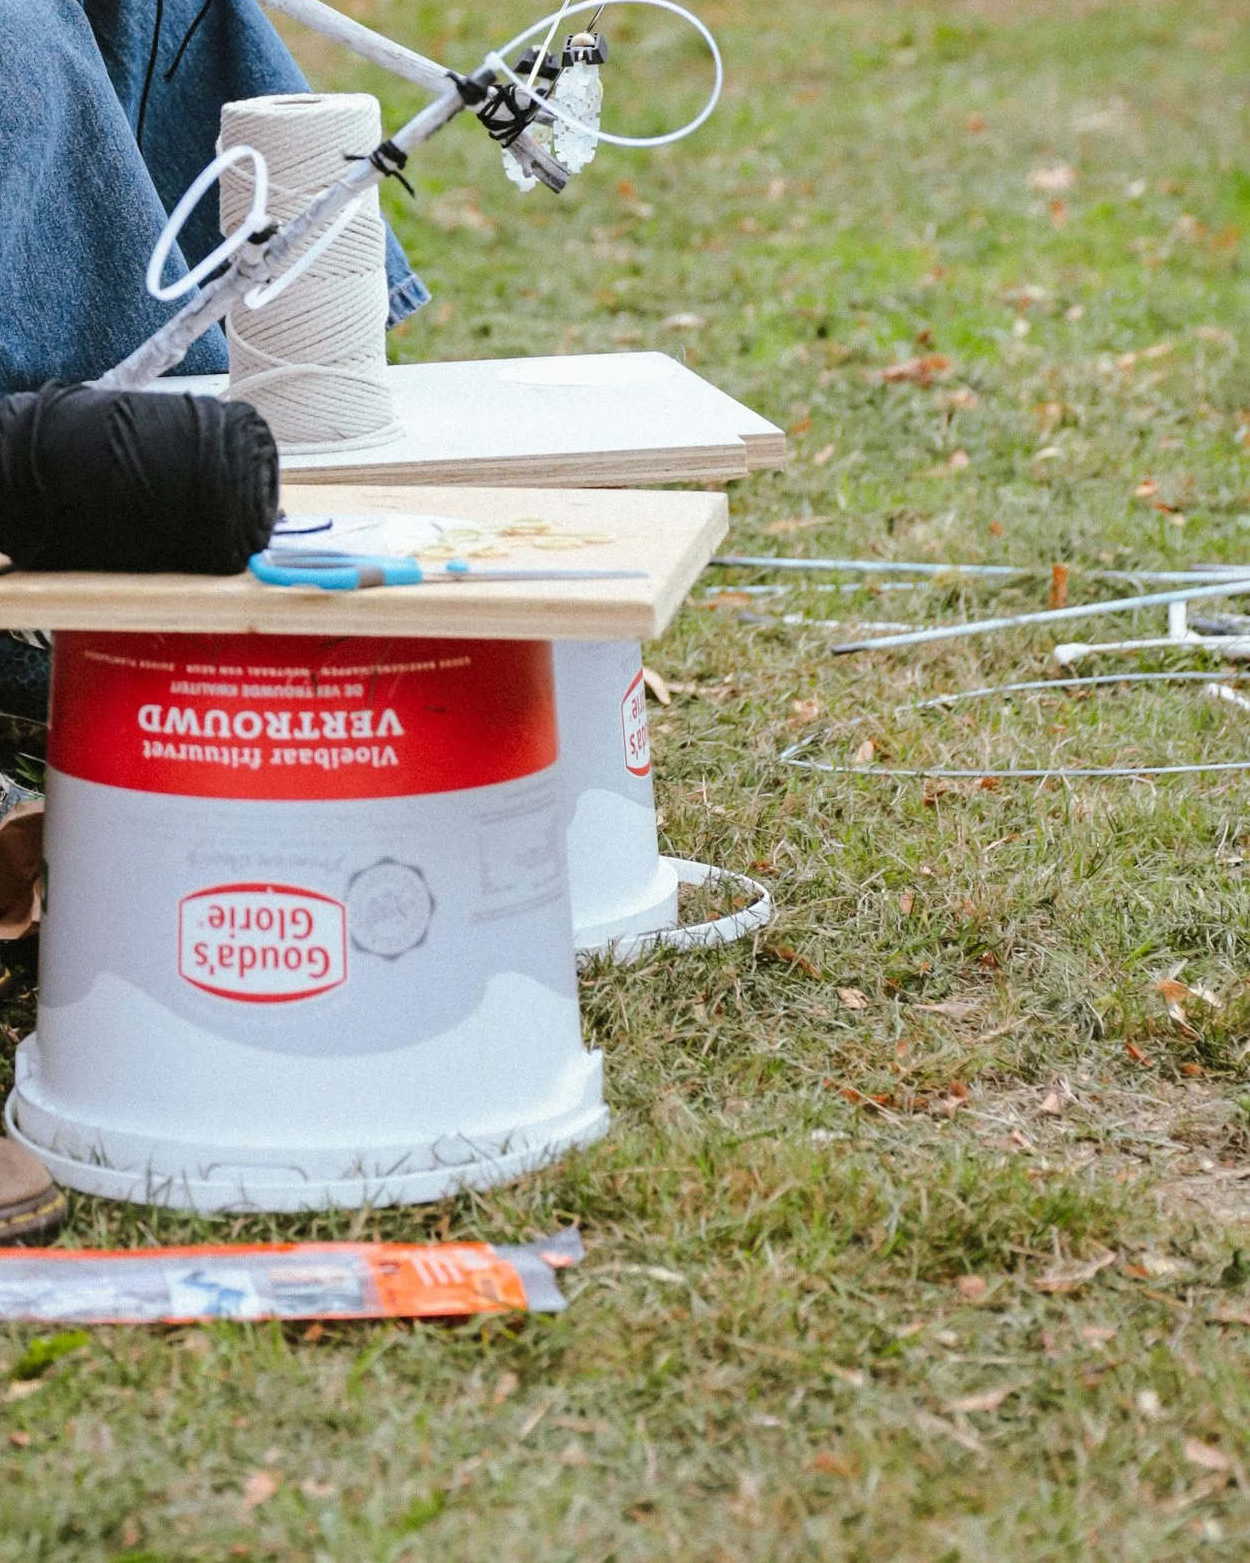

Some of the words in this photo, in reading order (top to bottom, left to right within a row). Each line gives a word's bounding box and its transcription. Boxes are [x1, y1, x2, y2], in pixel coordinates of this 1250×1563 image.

[138, 703, 405, 740] VERTROUWD
[142, 739, 263, 770] frituurvet
[269, 744, 399, 770] Vloeibaar
[208, 904, 314, 940] Glorie
[193, 941, 331, 979] Gouda's
